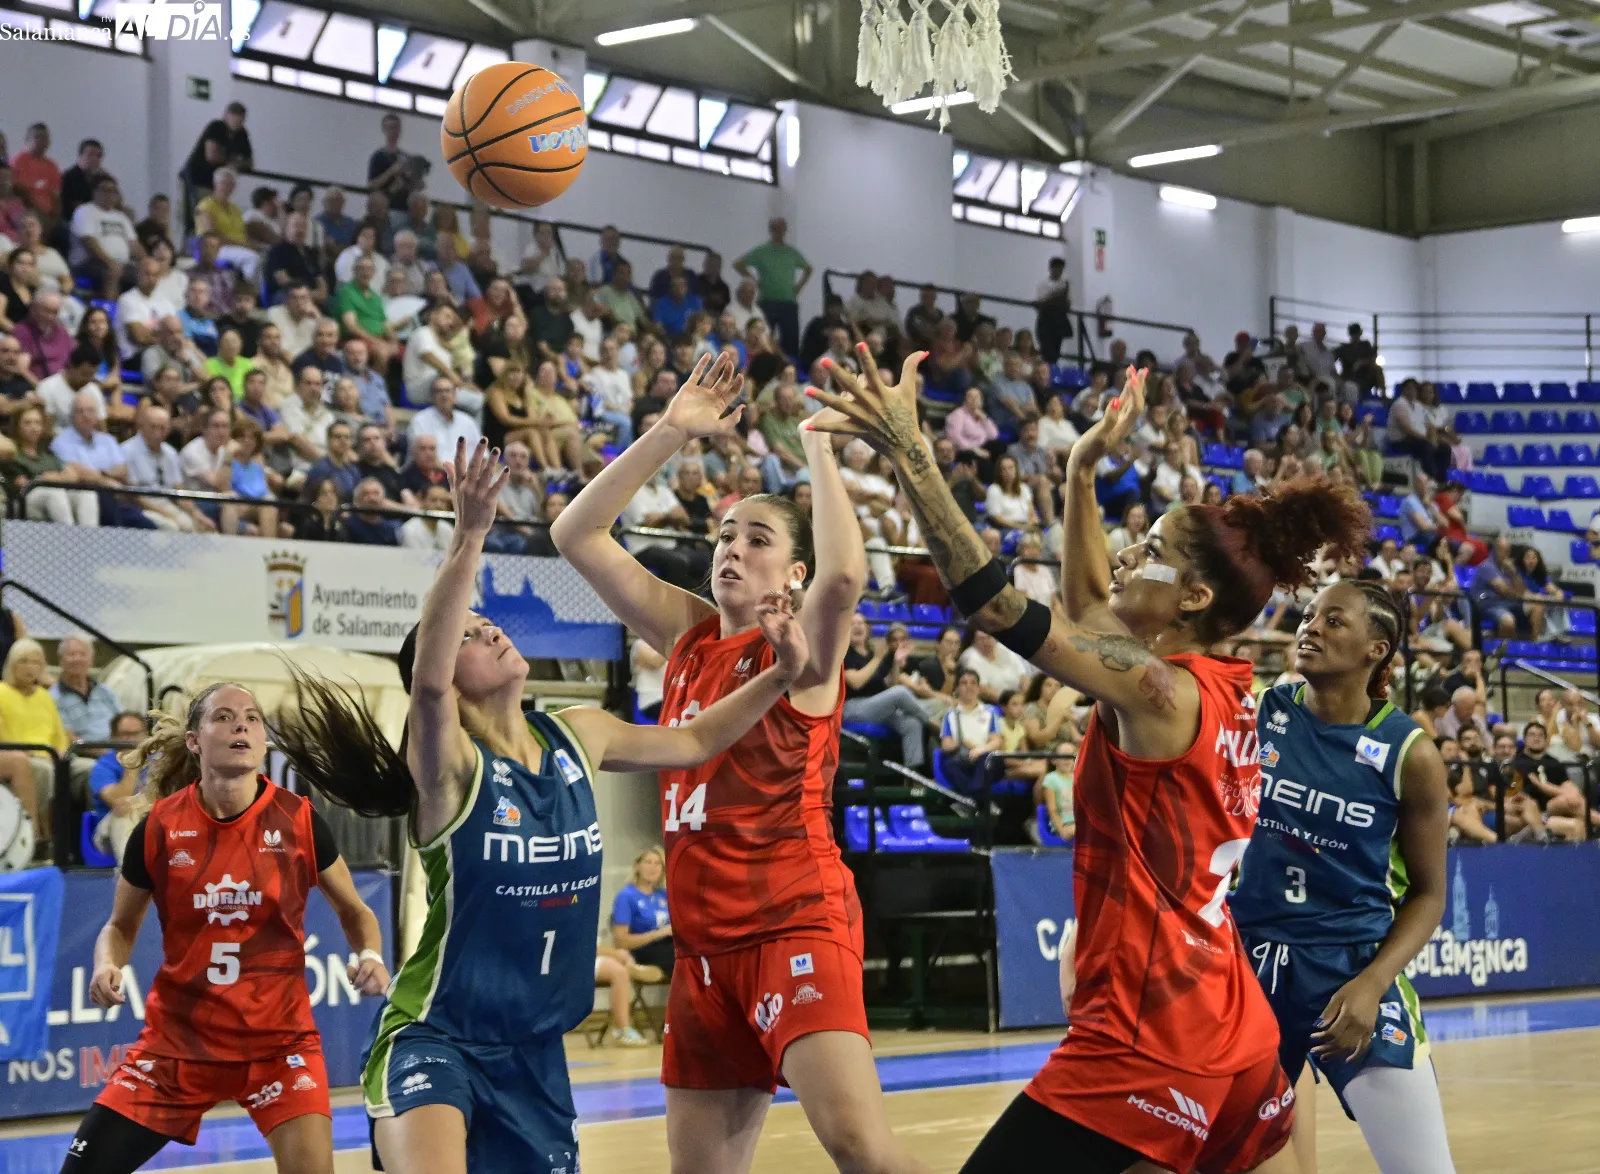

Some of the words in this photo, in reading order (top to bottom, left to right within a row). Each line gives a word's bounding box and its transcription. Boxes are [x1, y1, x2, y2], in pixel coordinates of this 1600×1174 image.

[312, 583, 418, 610] Ayuntamiento
[312, 613, 332, 636] de
[664, 782, 707, 832] 14
[1303, 831, 1312, 841] Y
[495, 885, 558, 897] CASTILLA
[561, 881, 570, 893] Y
[1284, 865, 1308, 904] 3
[206, 942, 241, 986] 5
[540, 929, 557, 976] 1
[8, 1047, 75, 1084] NOS
